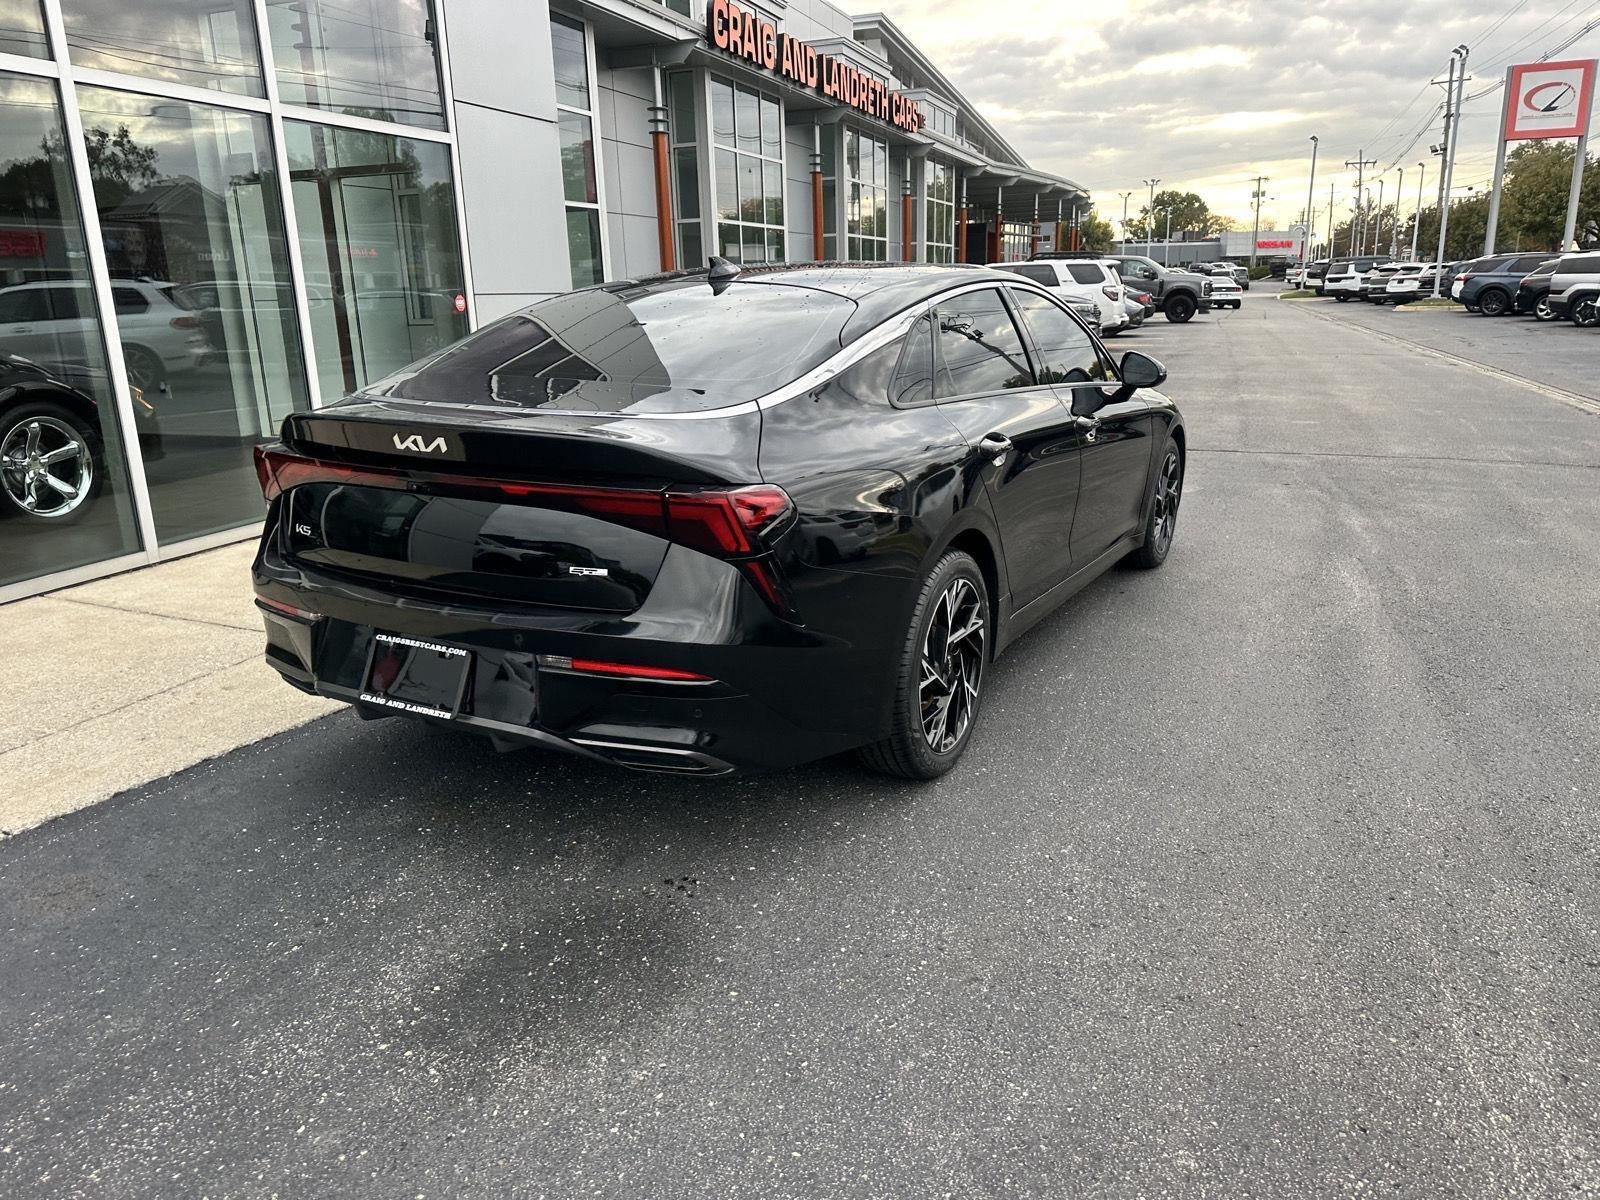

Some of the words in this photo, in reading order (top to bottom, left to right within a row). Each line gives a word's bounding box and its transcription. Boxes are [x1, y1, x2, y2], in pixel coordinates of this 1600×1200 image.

[710, 0, 777, 70] CRAIG
[781, 34, 817, 88] AND
[821, 54, 889, 121] LANDRETH
[892, 90, 918, 133] CARS
[392, 433, 448, 454] KIA
[375, 634, 467, 657] CRAIGSBESTCARS.COM
[360, 693, 386, 705] CRAIG
[386, 699, 406, 709] AND
[405, 703, 452, 720] LANDRETH
